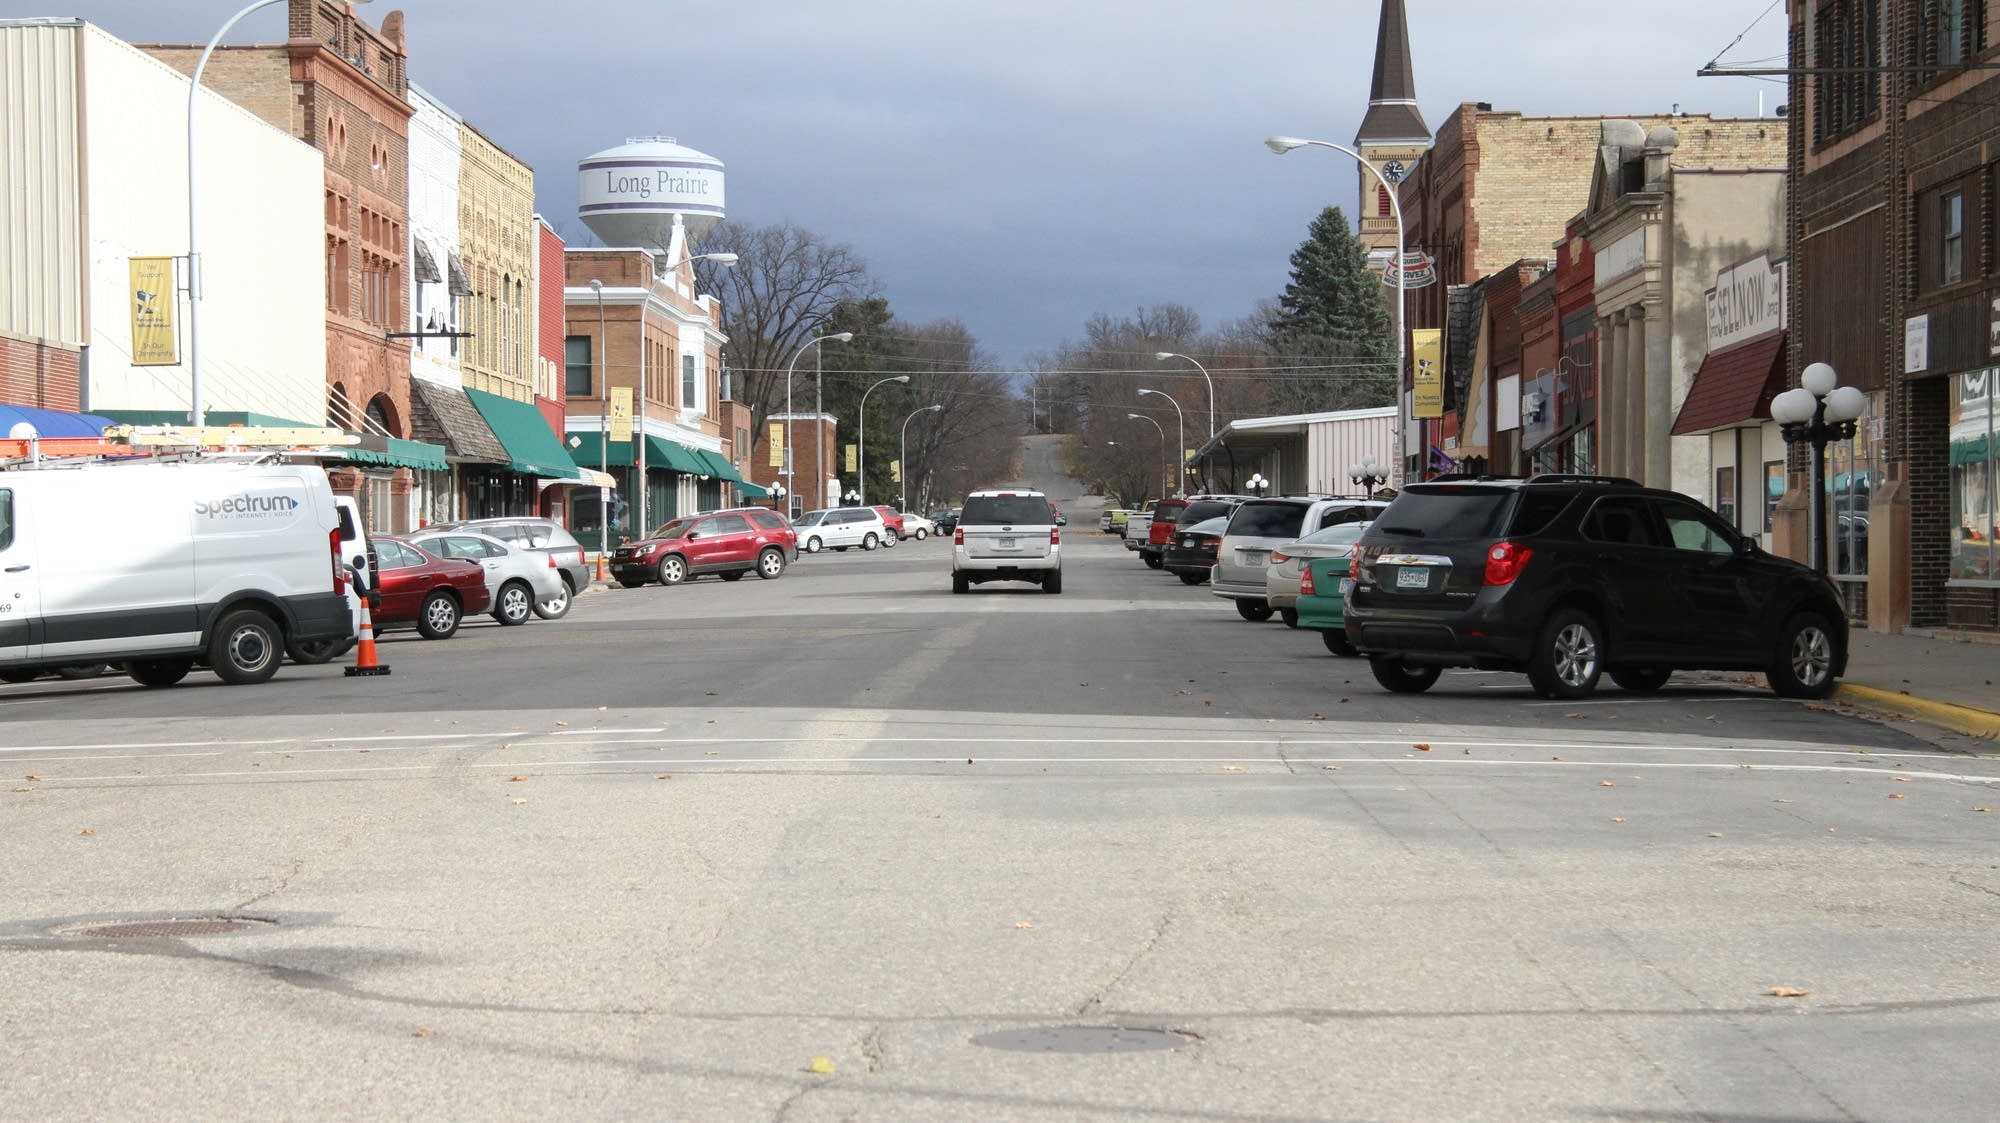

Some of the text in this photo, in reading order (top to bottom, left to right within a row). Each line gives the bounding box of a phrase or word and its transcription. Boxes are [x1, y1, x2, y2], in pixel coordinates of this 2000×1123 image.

[598, 170, 709, 198] Long Prairie
[1392, 270, 1426, 279] CAVEZ
[194, 494, 292, 519] Spectrum
